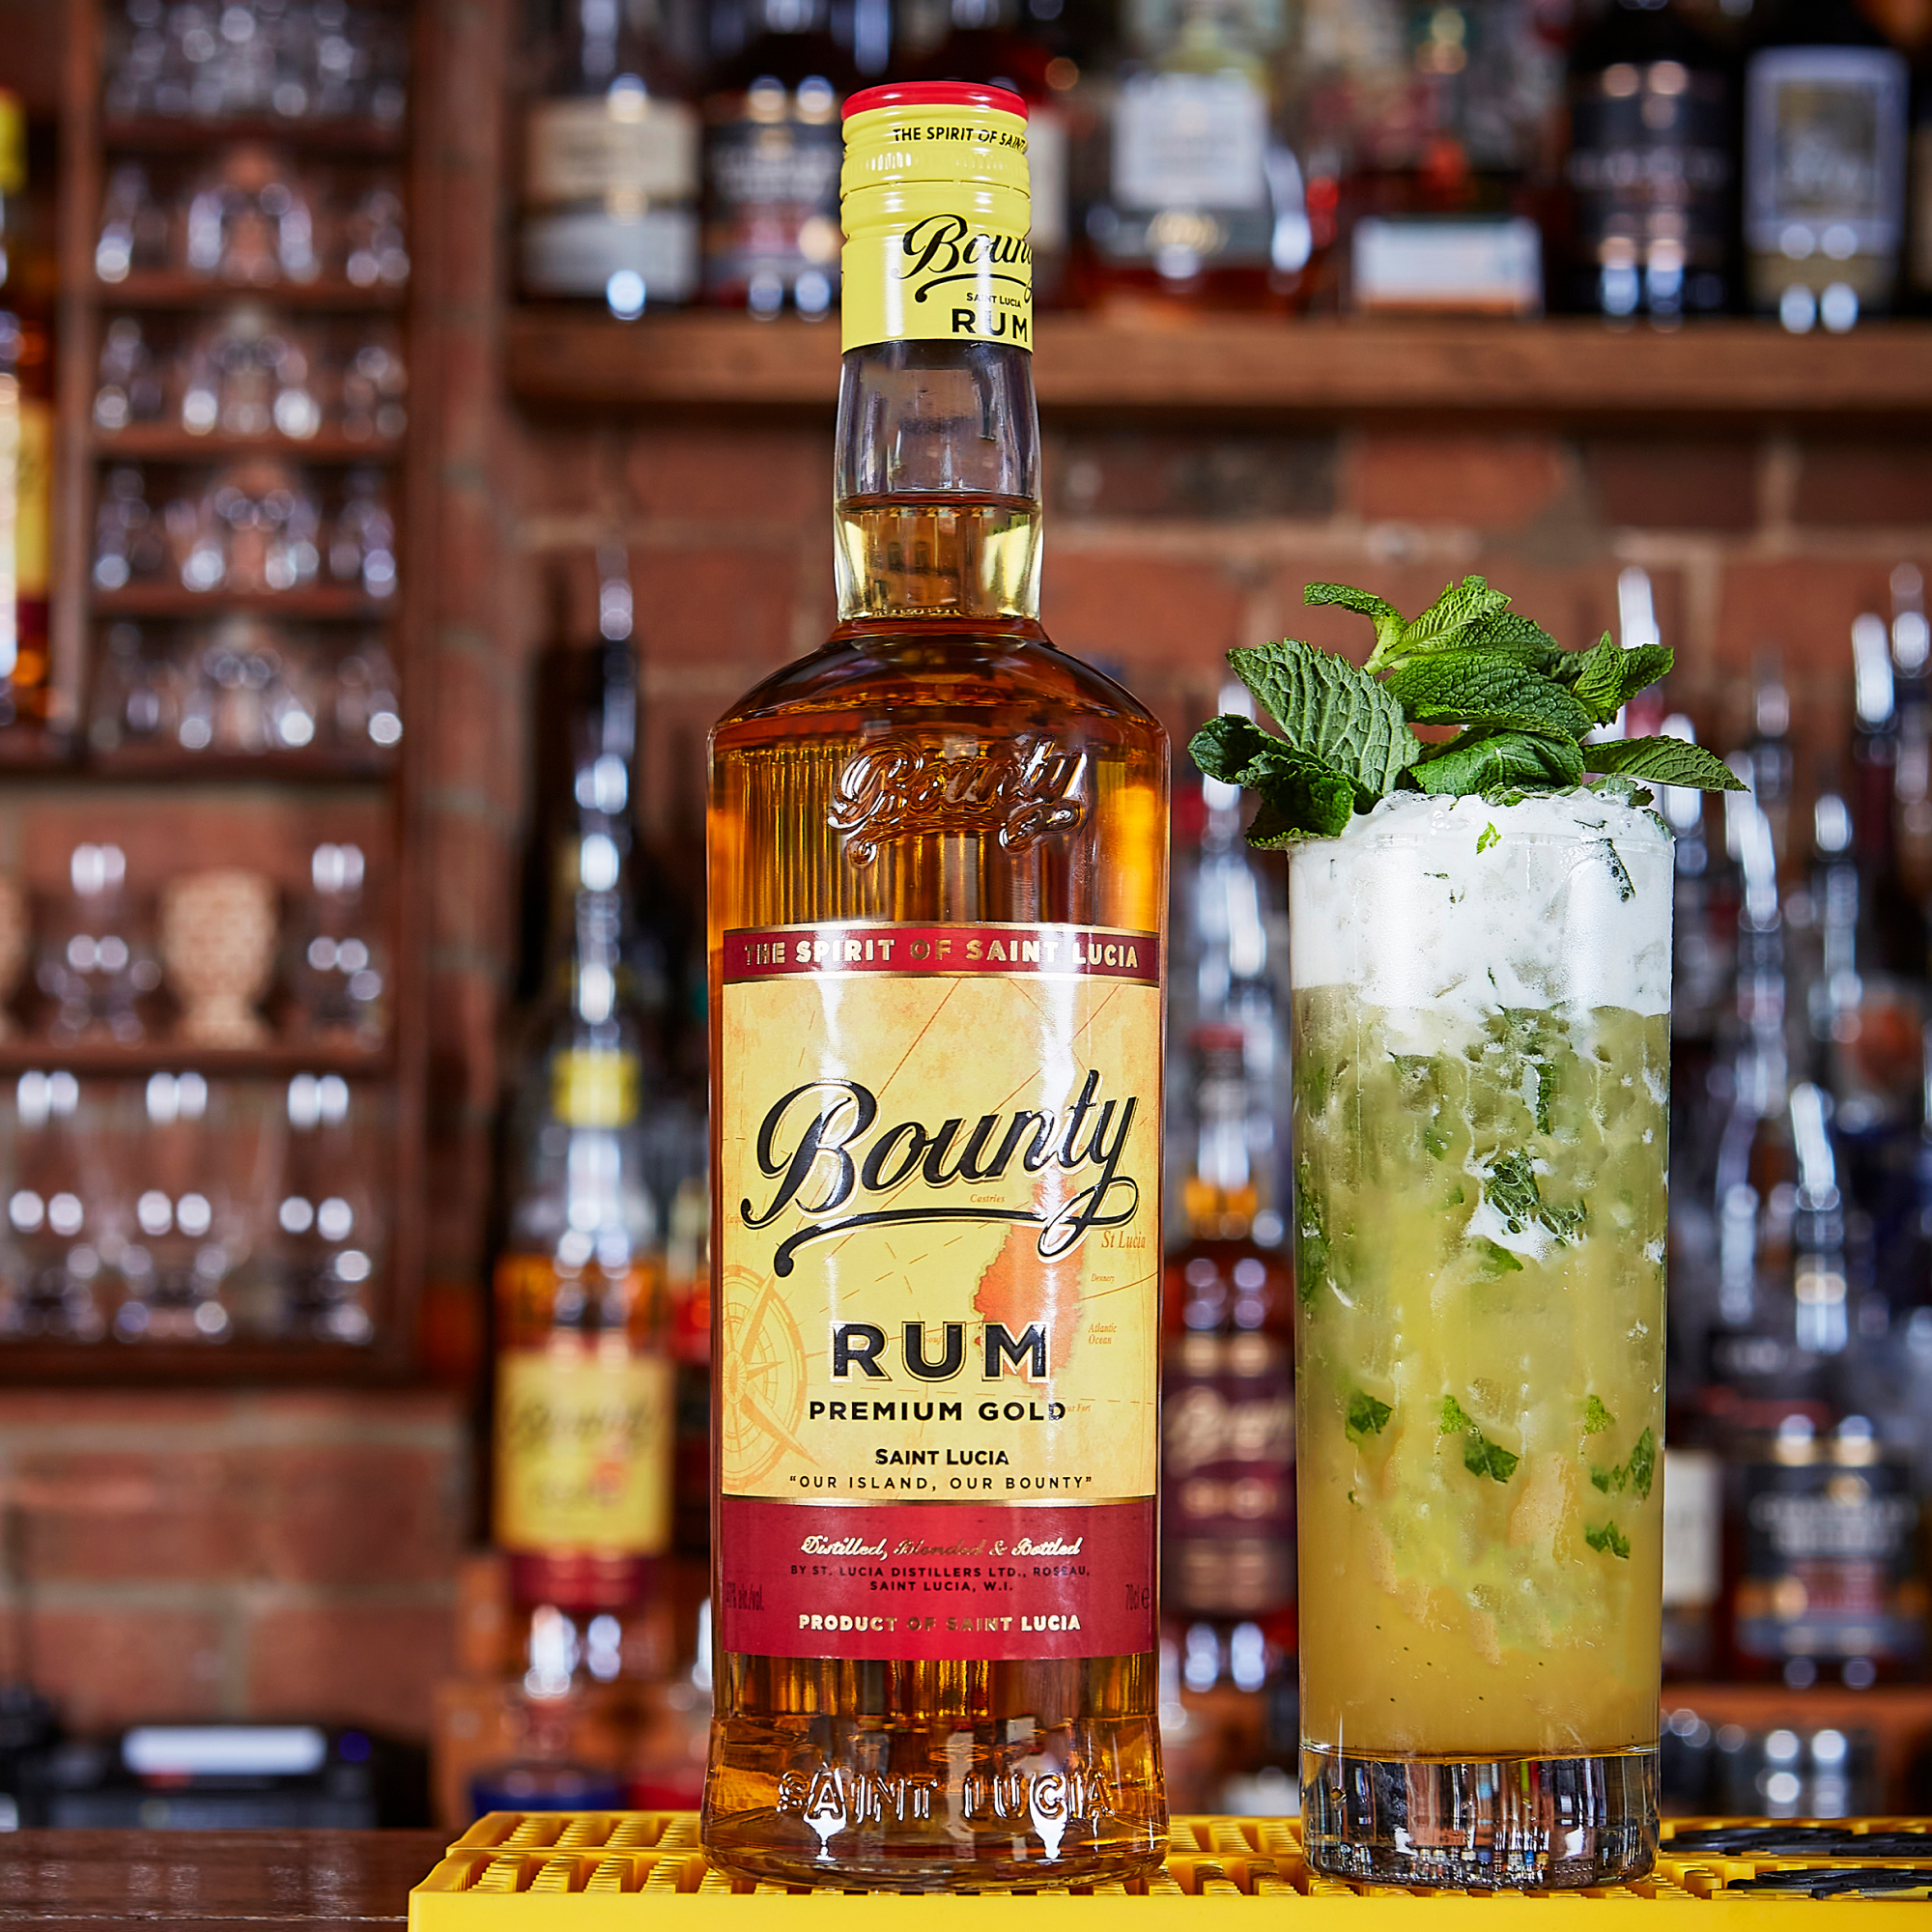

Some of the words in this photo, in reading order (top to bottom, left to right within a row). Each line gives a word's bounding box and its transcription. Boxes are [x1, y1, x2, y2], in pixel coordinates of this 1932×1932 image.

[894, 127, 921, 142] THE
[926, 127, 974, 142] SPIRIT
[979, 128, 998, 144] OF
[999, 132, 1026, 150] SAINT
[999, 295, 1022, 308] LUCIA
[951, 308, 1028, 343] RUM
[744, 942, 785, 966] THE
[795, 938, 895, 964] SPIRIT
[909, 938, 952, 961] OF
[965, 939, 1061, 965] SAINT
[1071, 943, 1139, 969] LUCIA
[740, 1068, 1140, 1278] Bounty
[969, 1193, 1006, 1204] Castries
[1100, 1229, 1116, 1248] St
[1118, 1230, 1147, 1249] Lucia
[1088, 1322, 1118, 1333] Atlantic
[1088, 1334, 1112, 1345] Ocean
[829, 1321, 1051, 1384] RUM
[809, 1401, 963, 1422] PREMIUM
[978, 1401, 1065, 1422] GOLD
[875, 1448, 940, 1466] SAINT
[946, 1448, 1010, 1466] LUCIA
[849, 1475, 937, 1492] ISLAND,
[950, 1476, 995, 1491] OUR
[800, 1535, 889, 1560] Distilled,
[893, 1538, 985, 1556] Blended
[988, 1539, 1009, 1557] &
[1010, 1536, 1084, 1557] Bottled
[790, 1565, 807, 1576] BY
[812, 1565, 833, 1577] ST.
[839, 1566, 884, 1577] LUCIA
[891, 1567, 982, 1577] DISTILLERS
[988, 1567, 1027, 1578] LTD.,
[1033, 1565, 1091, 1577] ROSEAU,
[869, 1580, 916, 1592] SAINT
[923, 1581, 977, 1593] LUCIA,
[983, 1581, 1014, 1592] W.I.
[798, 1614, 897, 1632] PRODUCT
[906, 1616, 937, 1632] OF
[946, 1616, 1012, 1632] SAINT
[1020, 1614, 1081, 1632] LUCIA
[776, 1766, 938, 1824] SAINT
